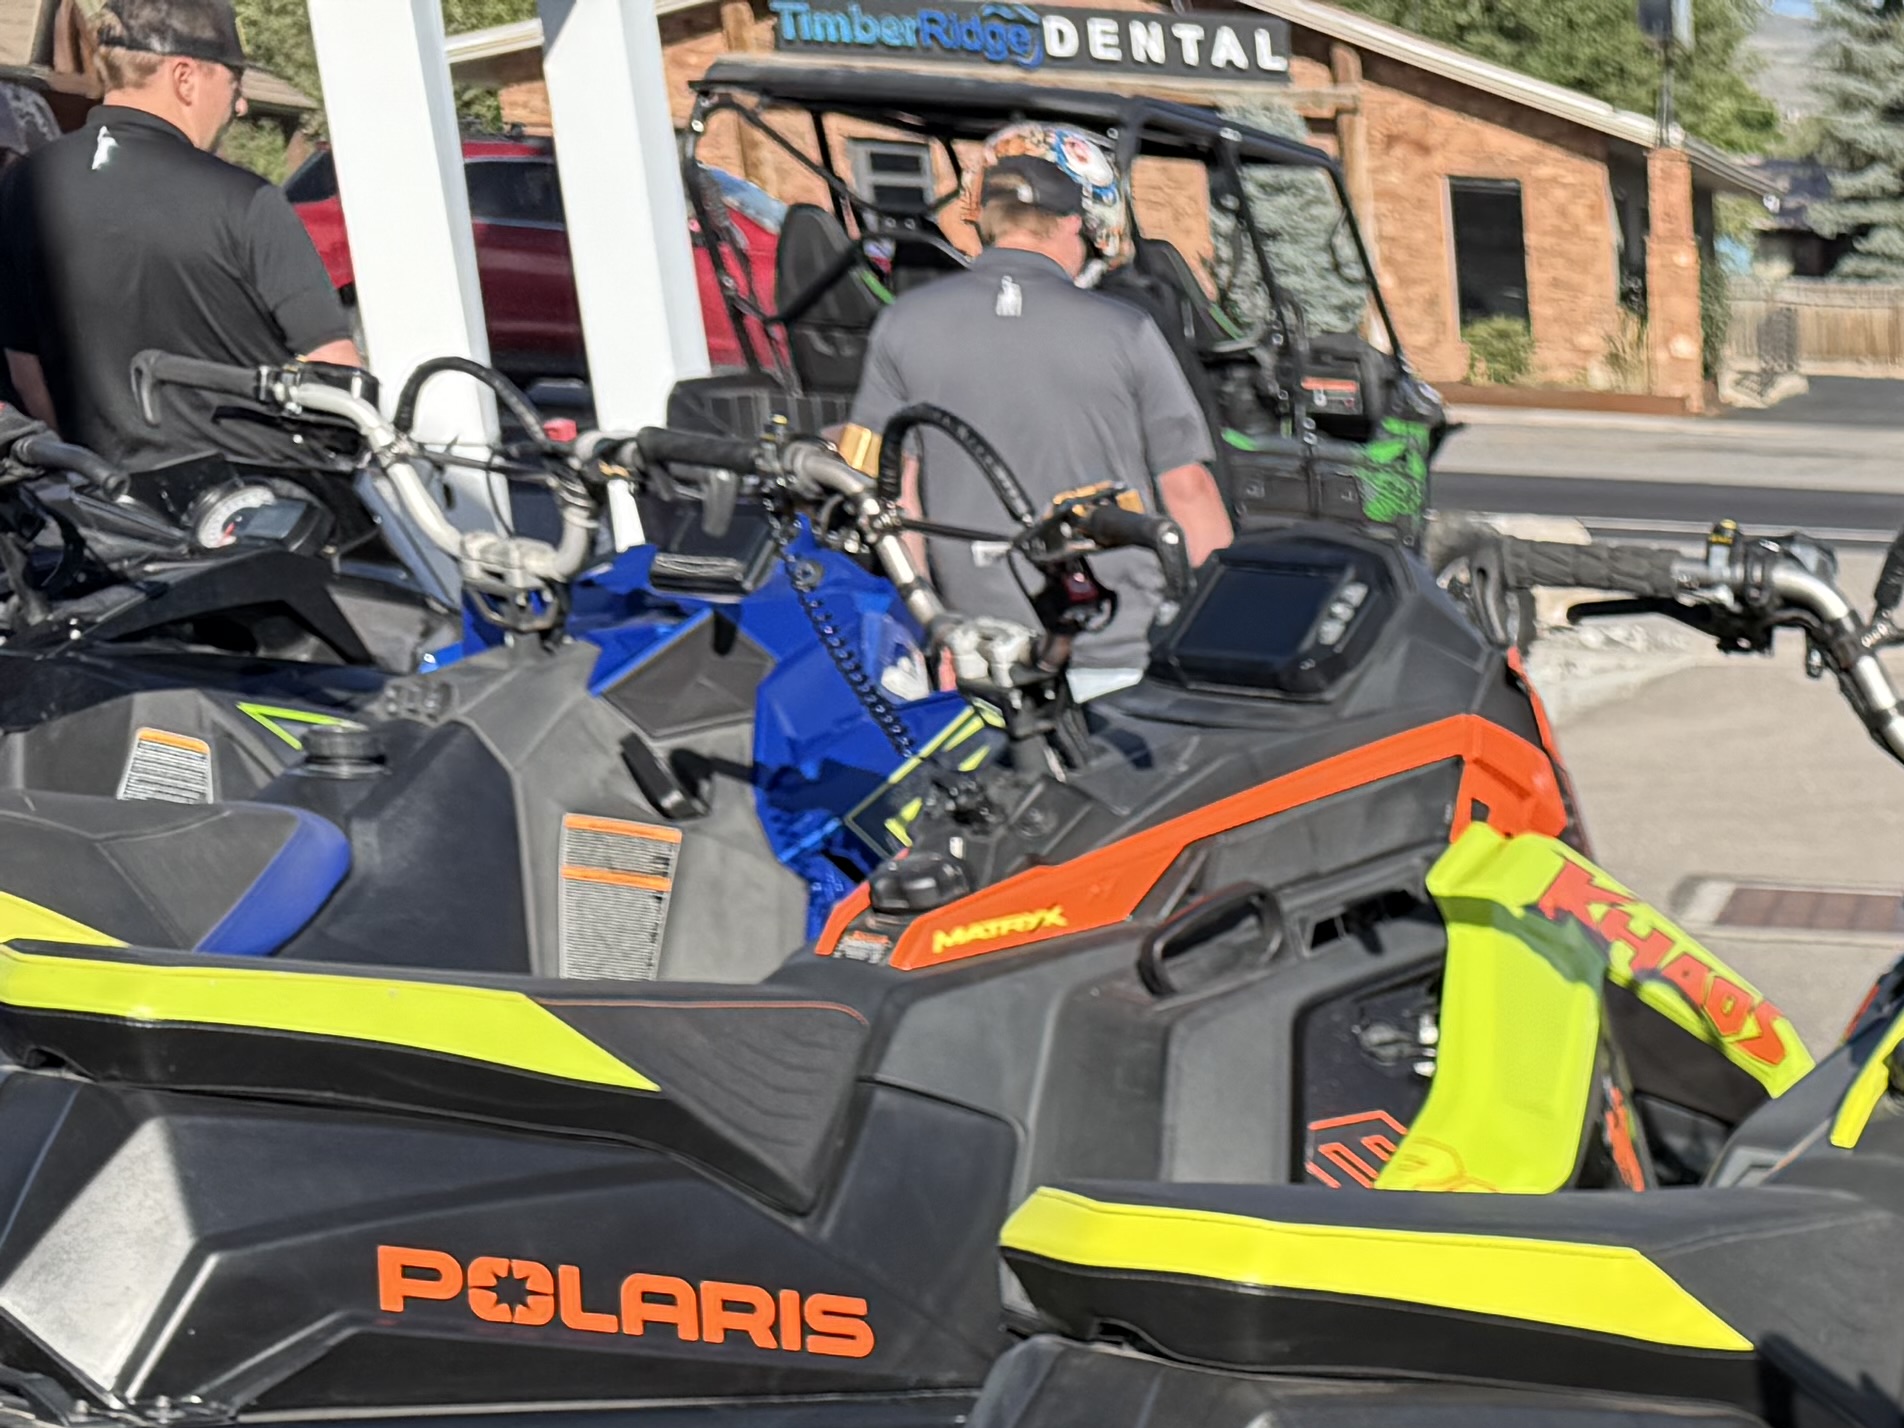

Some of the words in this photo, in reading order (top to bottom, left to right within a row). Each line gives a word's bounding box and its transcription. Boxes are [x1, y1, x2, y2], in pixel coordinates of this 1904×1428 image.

[1041, 14, 1288, 72] DENTAL
[932, 904, 1068, 953] MATRYX
[377, 1245, 875, 1358] POLARIS
